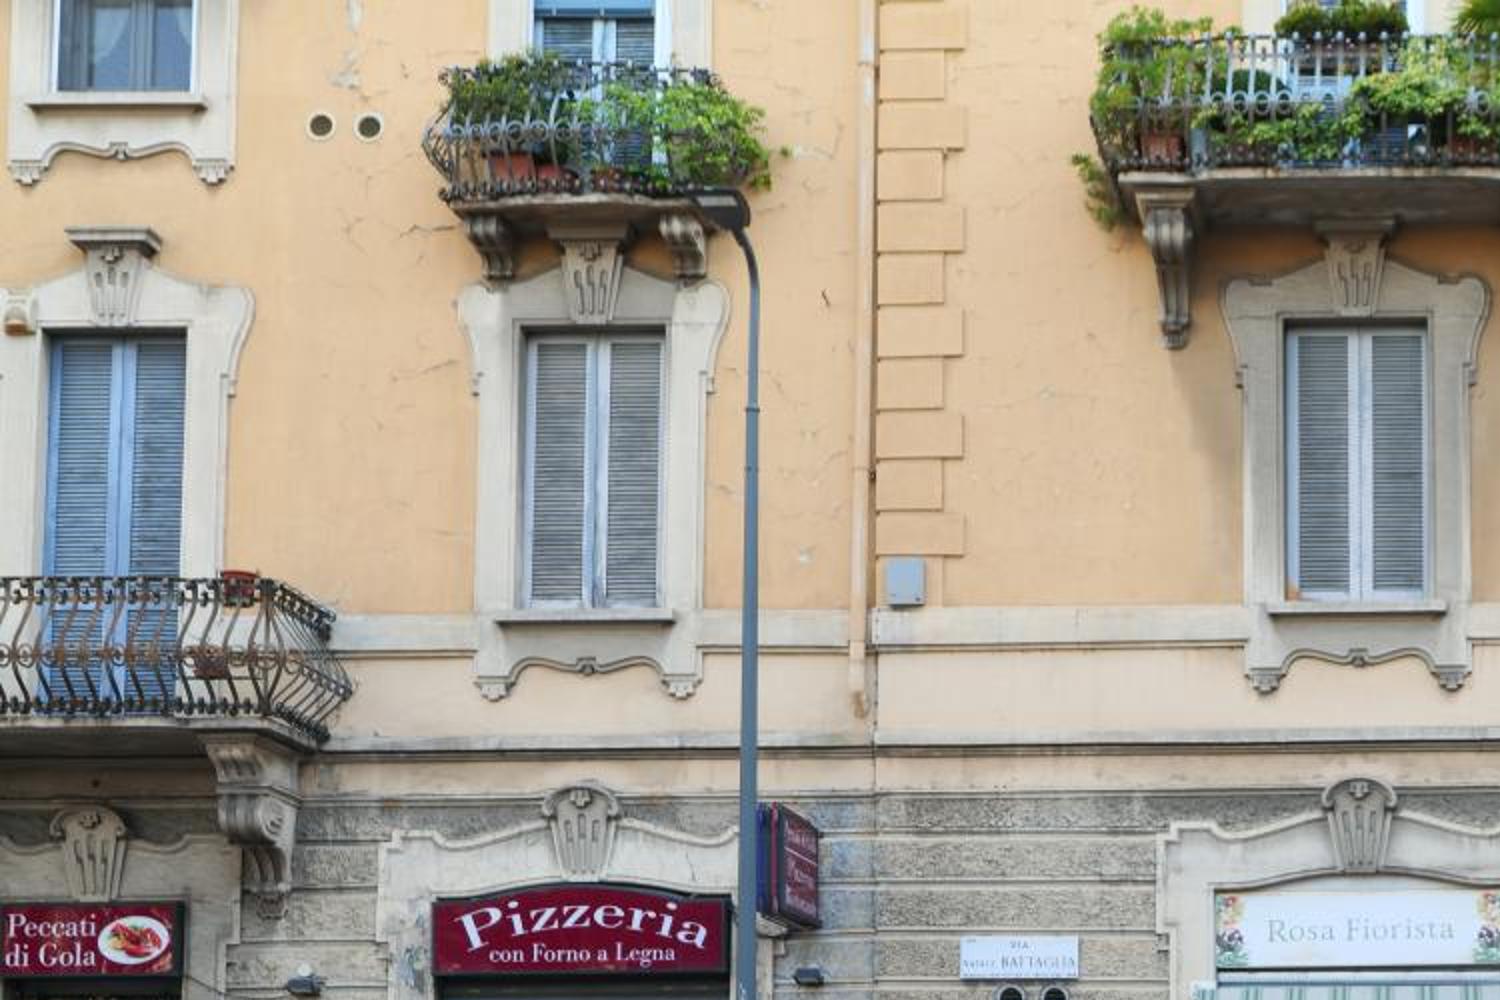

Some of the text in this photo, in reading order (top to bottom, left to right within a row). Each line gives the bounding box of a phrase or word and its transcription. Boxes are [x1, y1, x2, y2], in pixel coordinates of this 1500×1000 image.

[7, 914, 96, 938] Peccati
[456, 901, 708, 951] Pizzeria
[1267, 916, 1456, 944] Rosa Fiorista
[5, 943, 97, 967] di Gola
[489, 943, 675, 965] con Forno a Legna
[1009, 940, 1029, 949] VIA
